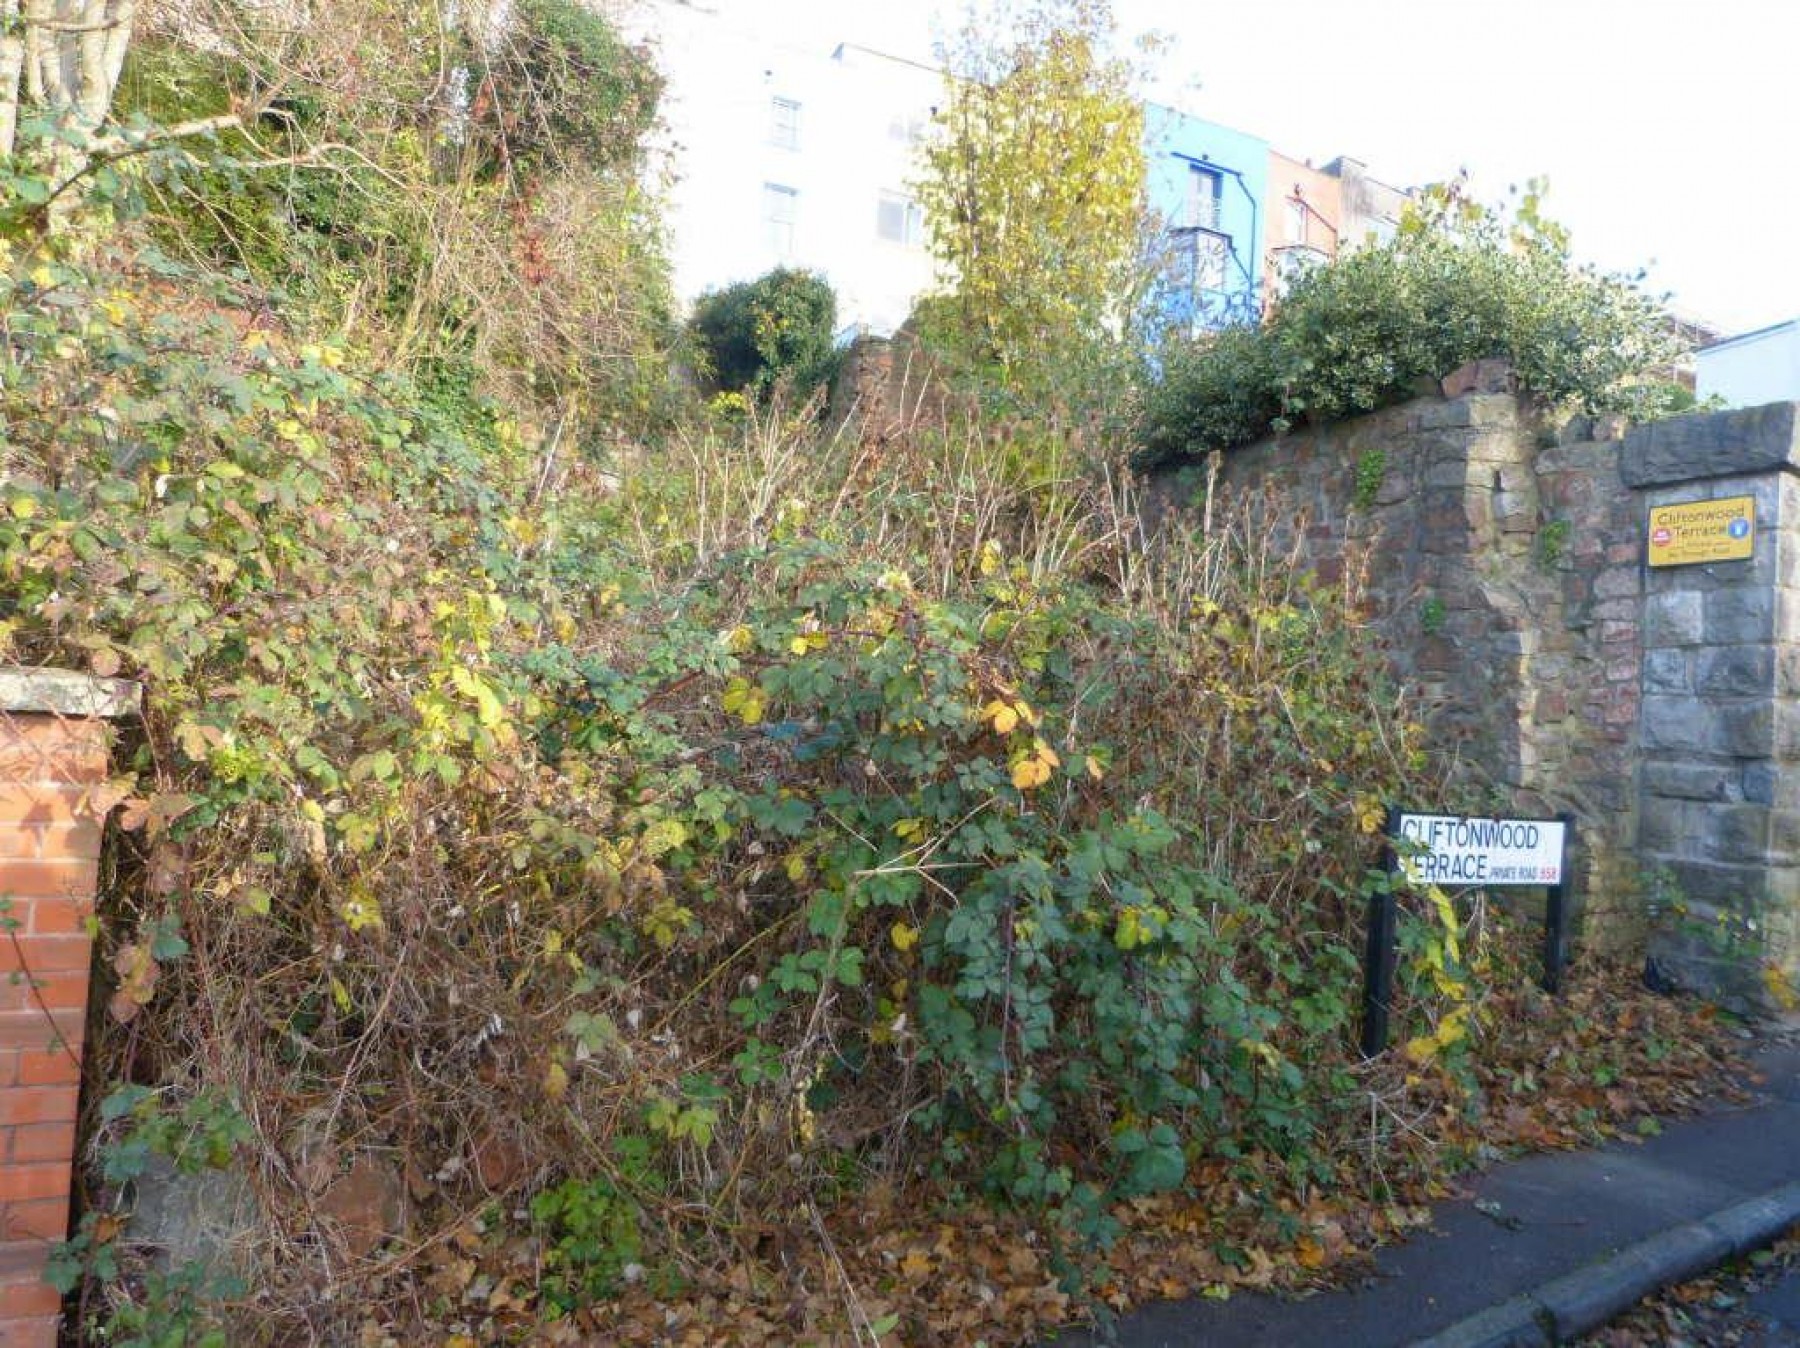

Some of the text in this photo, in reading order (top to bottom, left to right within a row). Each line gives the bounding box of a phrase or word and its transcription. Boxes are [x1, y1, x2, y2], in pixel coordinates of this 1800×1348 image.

[1657, 504, 1745, 525] Cliftonwood
[1402, 818, 1539, 849] CLIFTONWOOD
[1410, 851, 1488, 880] ERRACE
